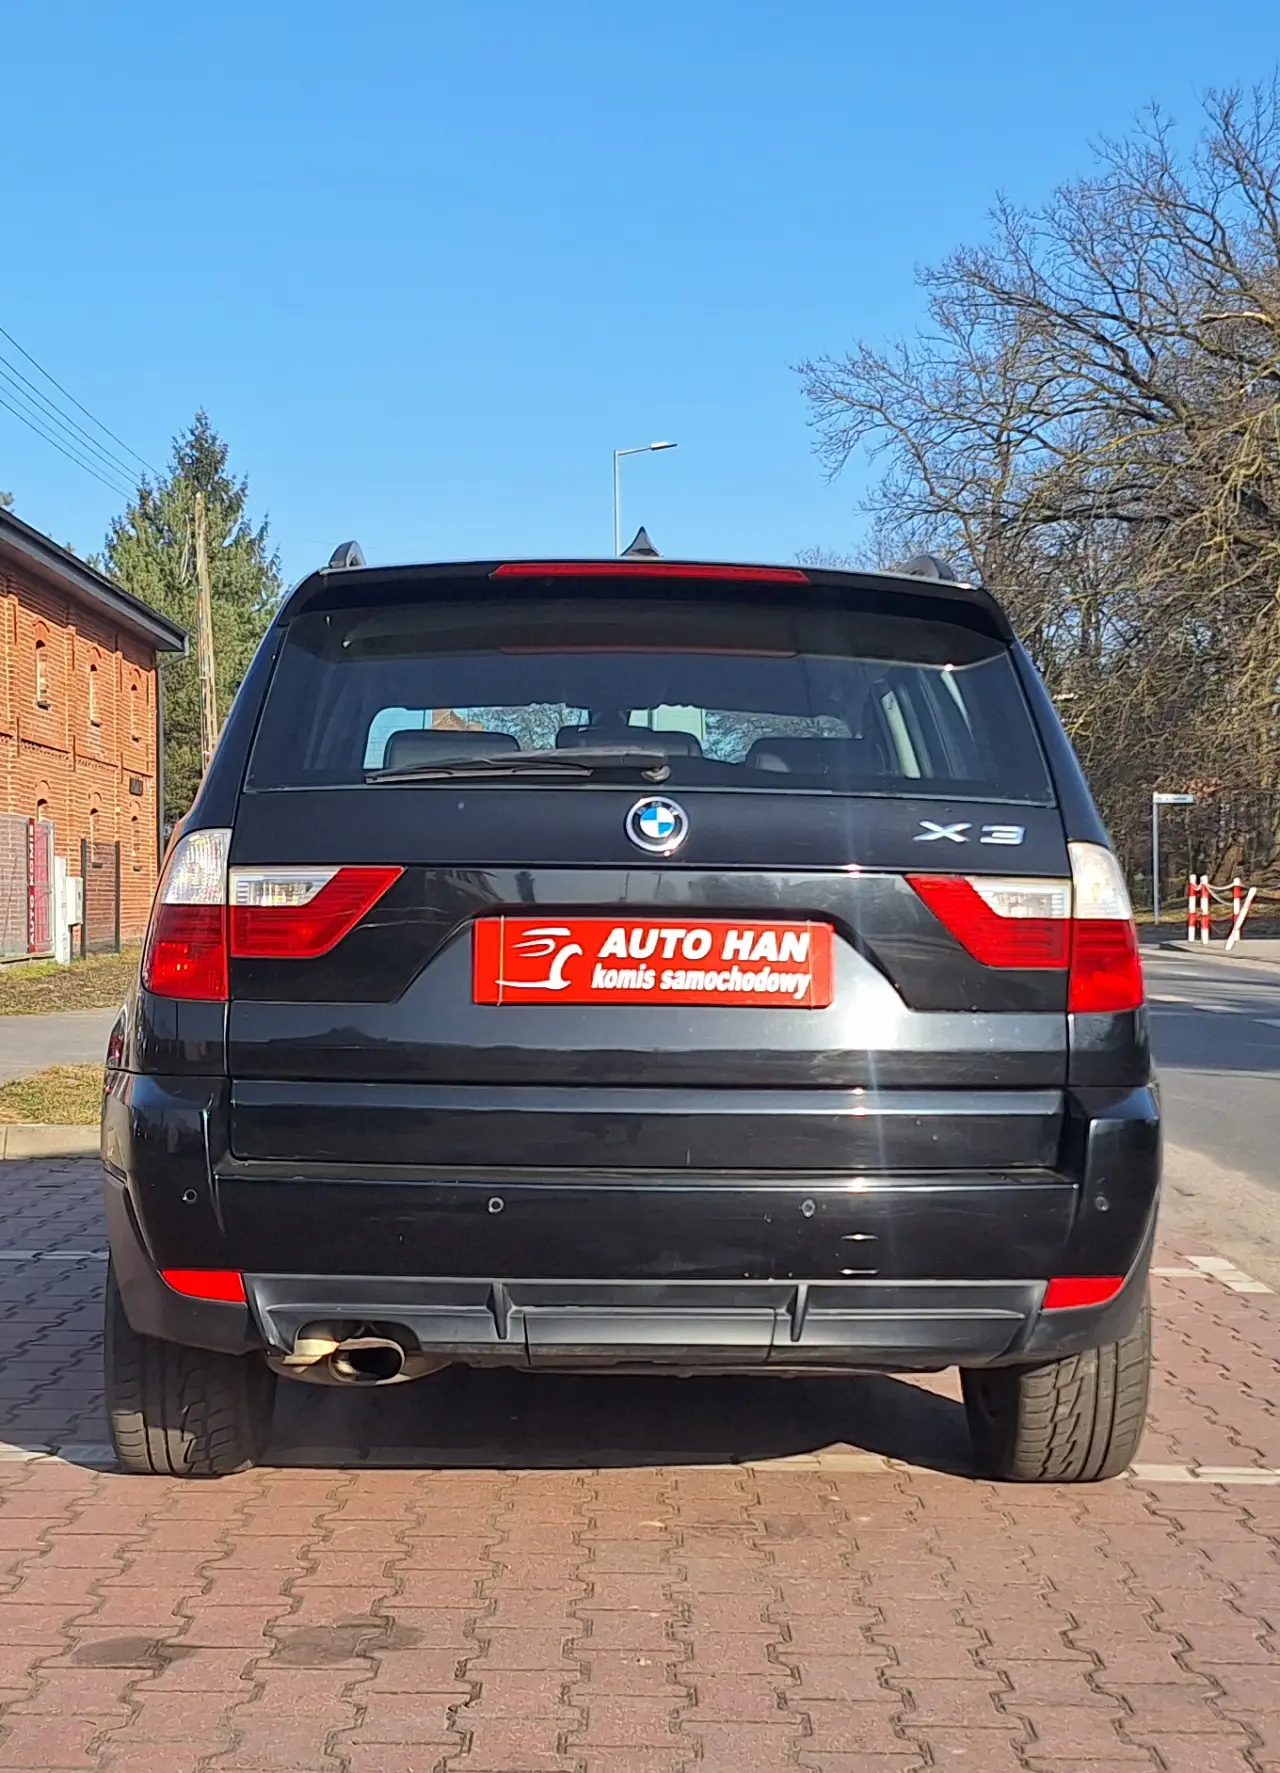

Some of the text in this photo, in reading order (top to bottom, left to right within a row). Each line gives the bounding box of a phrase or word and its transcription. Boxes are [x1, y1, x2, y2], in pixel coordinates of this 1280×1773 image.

[596, 927, 811, 963] AUTO HAN
[591, 963, 812, 1000] komis samochodowy
